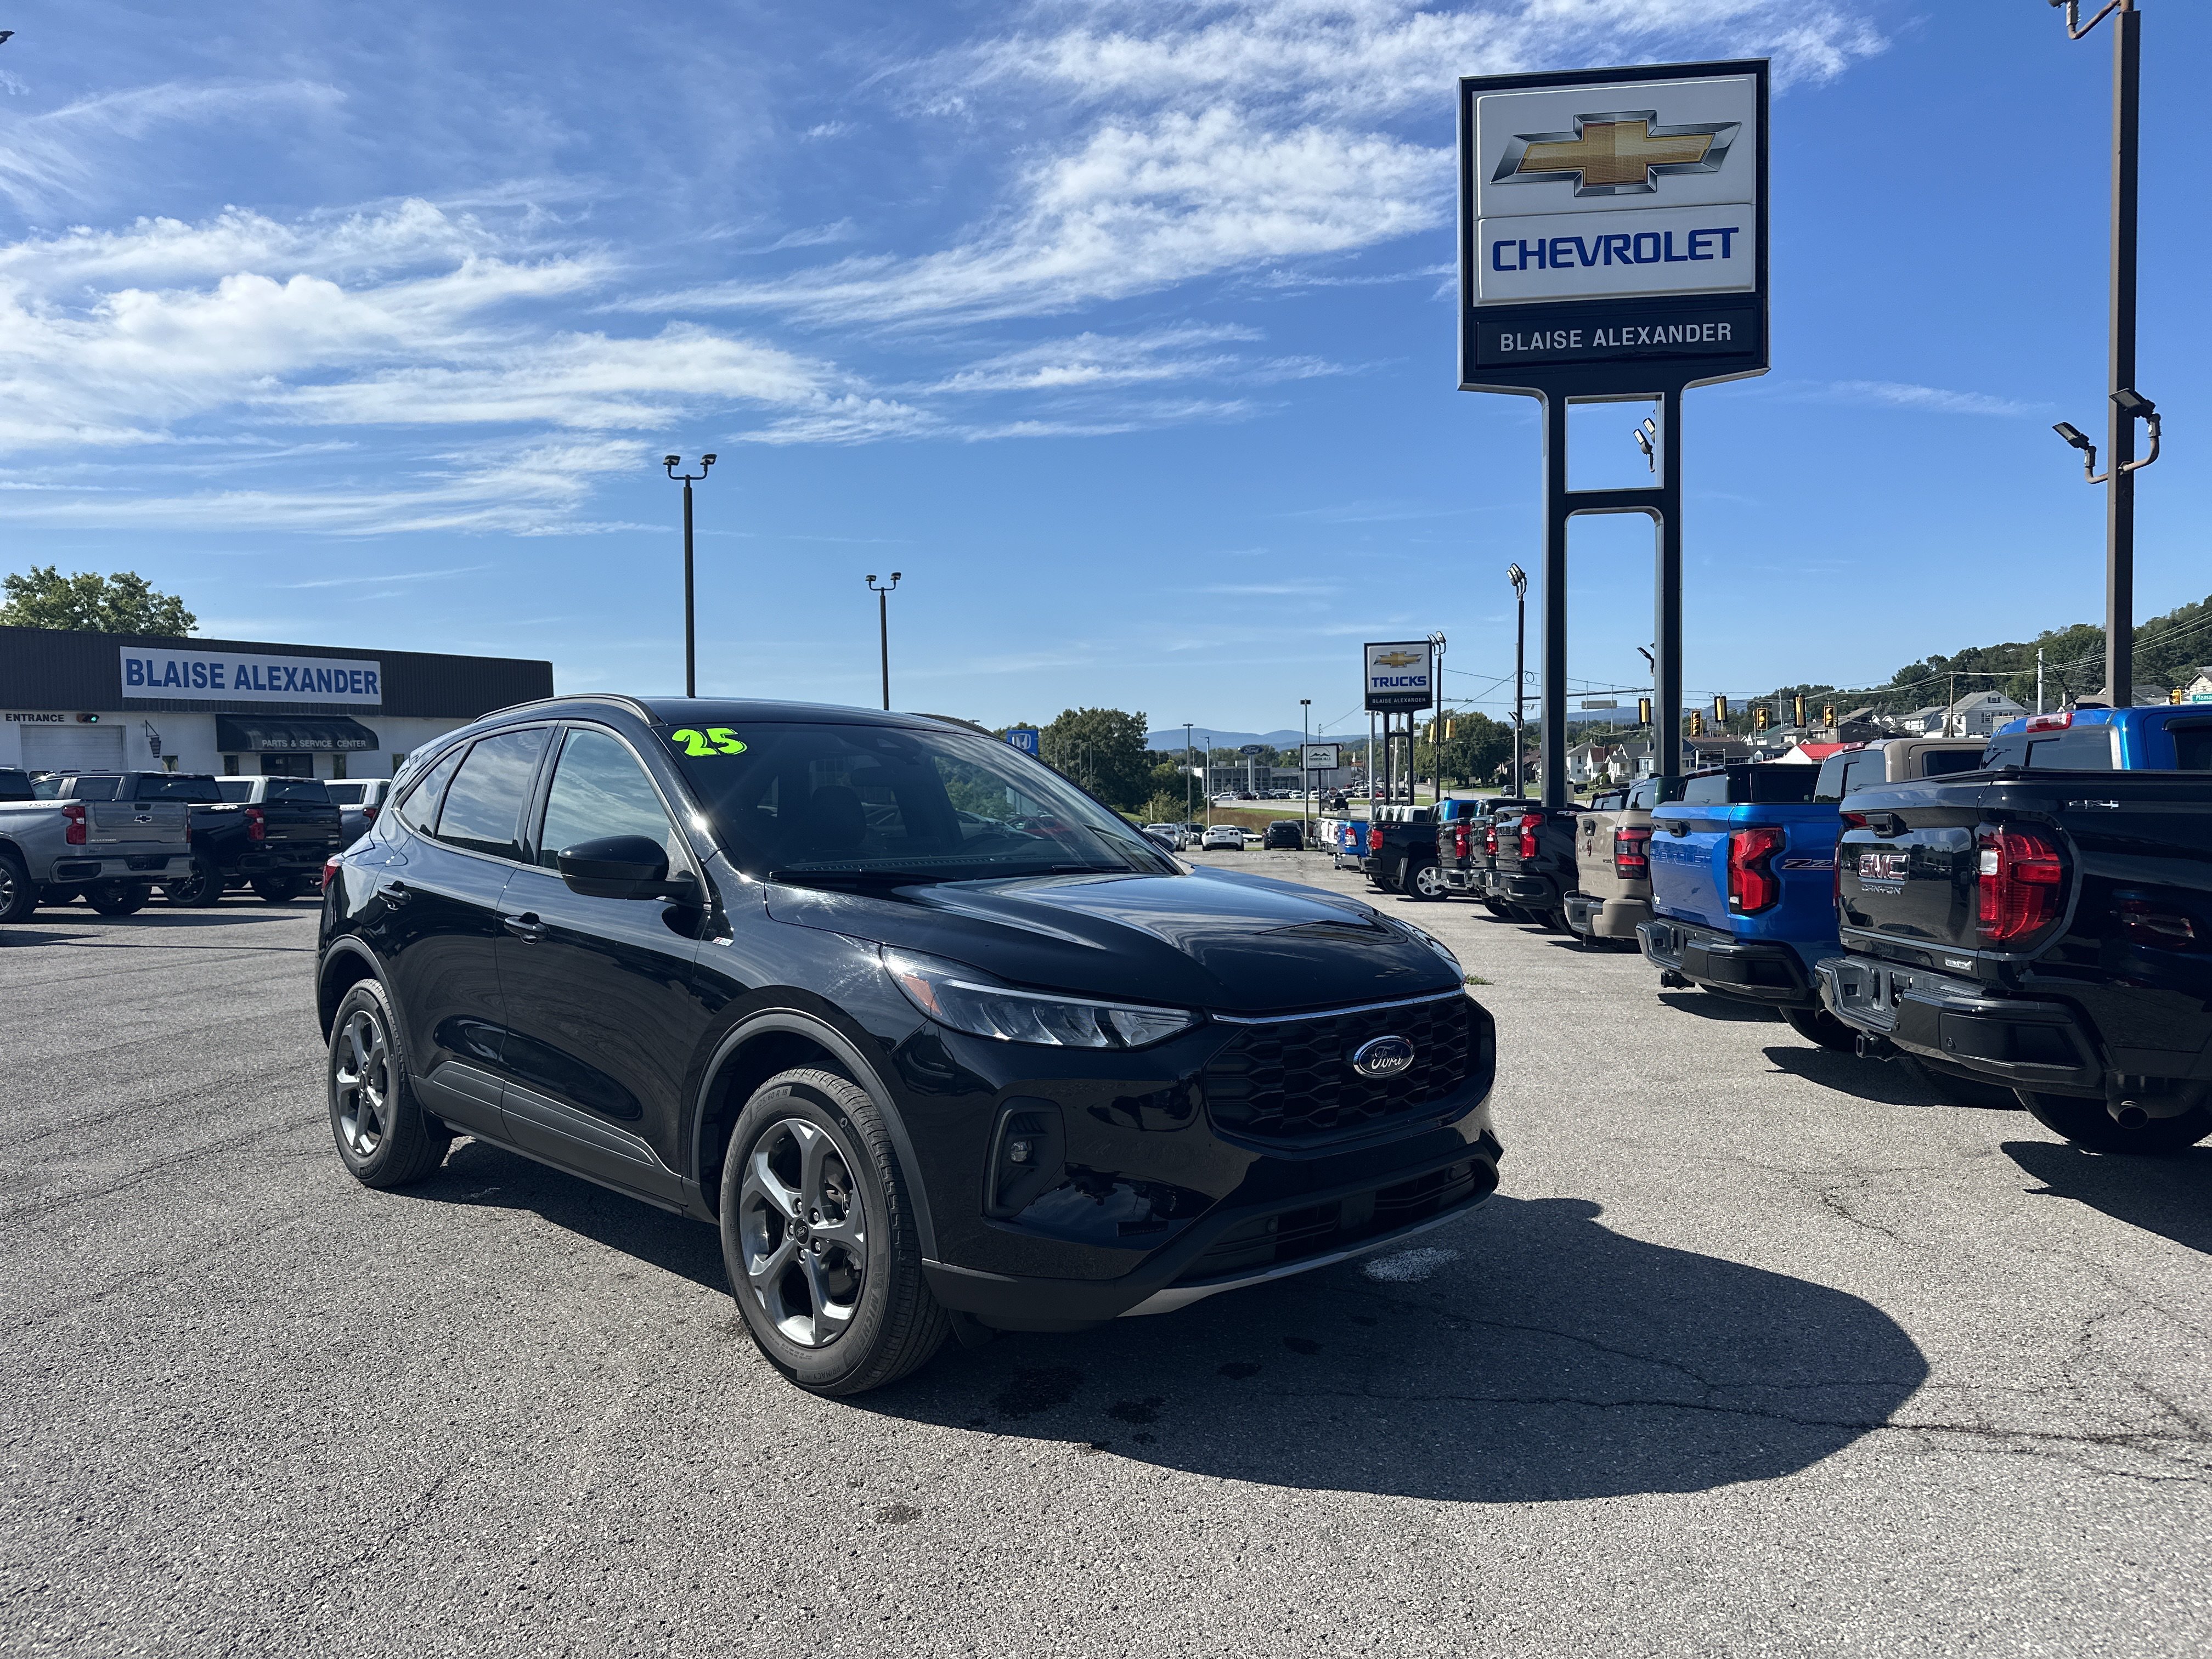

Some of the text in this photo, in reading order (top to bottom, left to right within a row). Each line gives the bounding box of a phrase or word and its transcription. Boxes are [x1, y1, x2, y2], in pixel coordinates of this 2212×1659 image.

[1492, 227, 1739, 271] CHEVROLET
[1500, 323, 1731, 352] BLAISE ALEXANDER
[126, 659, 379, 695] BLAISE ALEXANDER
[1372, 676, 1426, 687] TRUCKS
[5, 714, 65, 722] ENTRANCE
[672, 727, 747, 757] 25
[1859, 854, 1908, 880] GMC
[1861, 884, 1903, 895] CANYON
[1372, 1045, 1403, 1069] Ford
